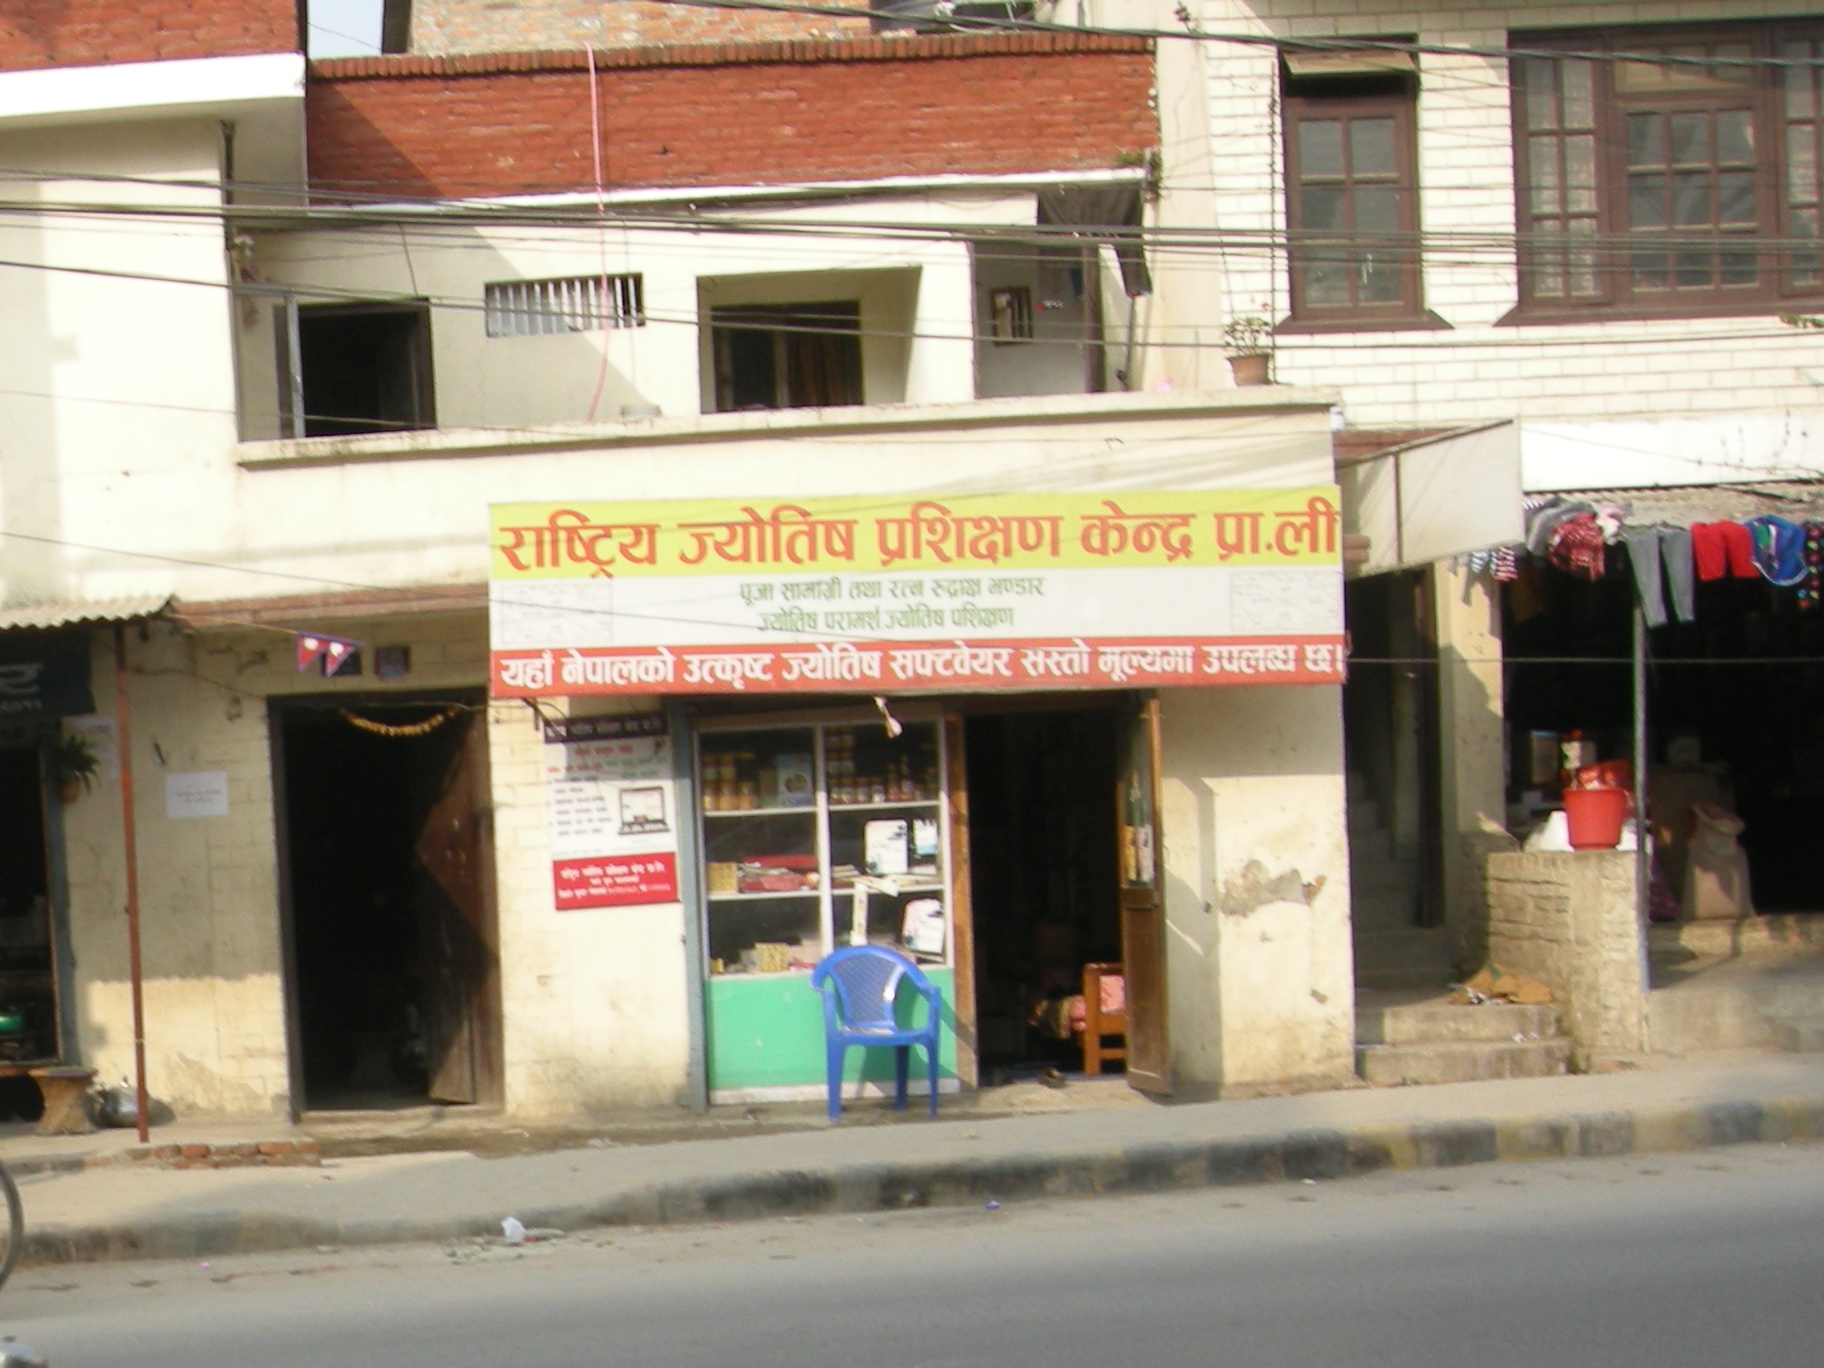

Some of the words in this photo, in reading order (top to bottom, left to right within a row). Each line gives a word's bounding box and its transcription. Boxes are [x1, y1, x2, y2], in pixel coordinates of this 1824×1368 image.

[499, 509, 660, 578] राष्ट्रिय
[677, 504, 858, 565] ज्योतिष
[875, 501, 1065, 567] प्रशिक्षण
[1080, 500, 1196, 563] केन्द्र
[740, 581, 774, 607] पूजा
[848, 579, 882, 600] तथा
[987, 576, 1047, 597] भण्डार
[758, 604, 818, 632] ज्योतिष
[500, 649, 552, 689] यहाँ
[561, 648, 675, 685] नेपालको
[683, 652, 776, 689] उत्कृष्ट
[782, 643, 882, 681] ज्योतिष
[889, 639, 1015, 679] सफ्टवेयर
[1021, 638, 1092, 676] सस्तो
[1098, 643, 1195, 682] मूल्यमा
[1201, 643, 1297, 676] उपलब्ध
